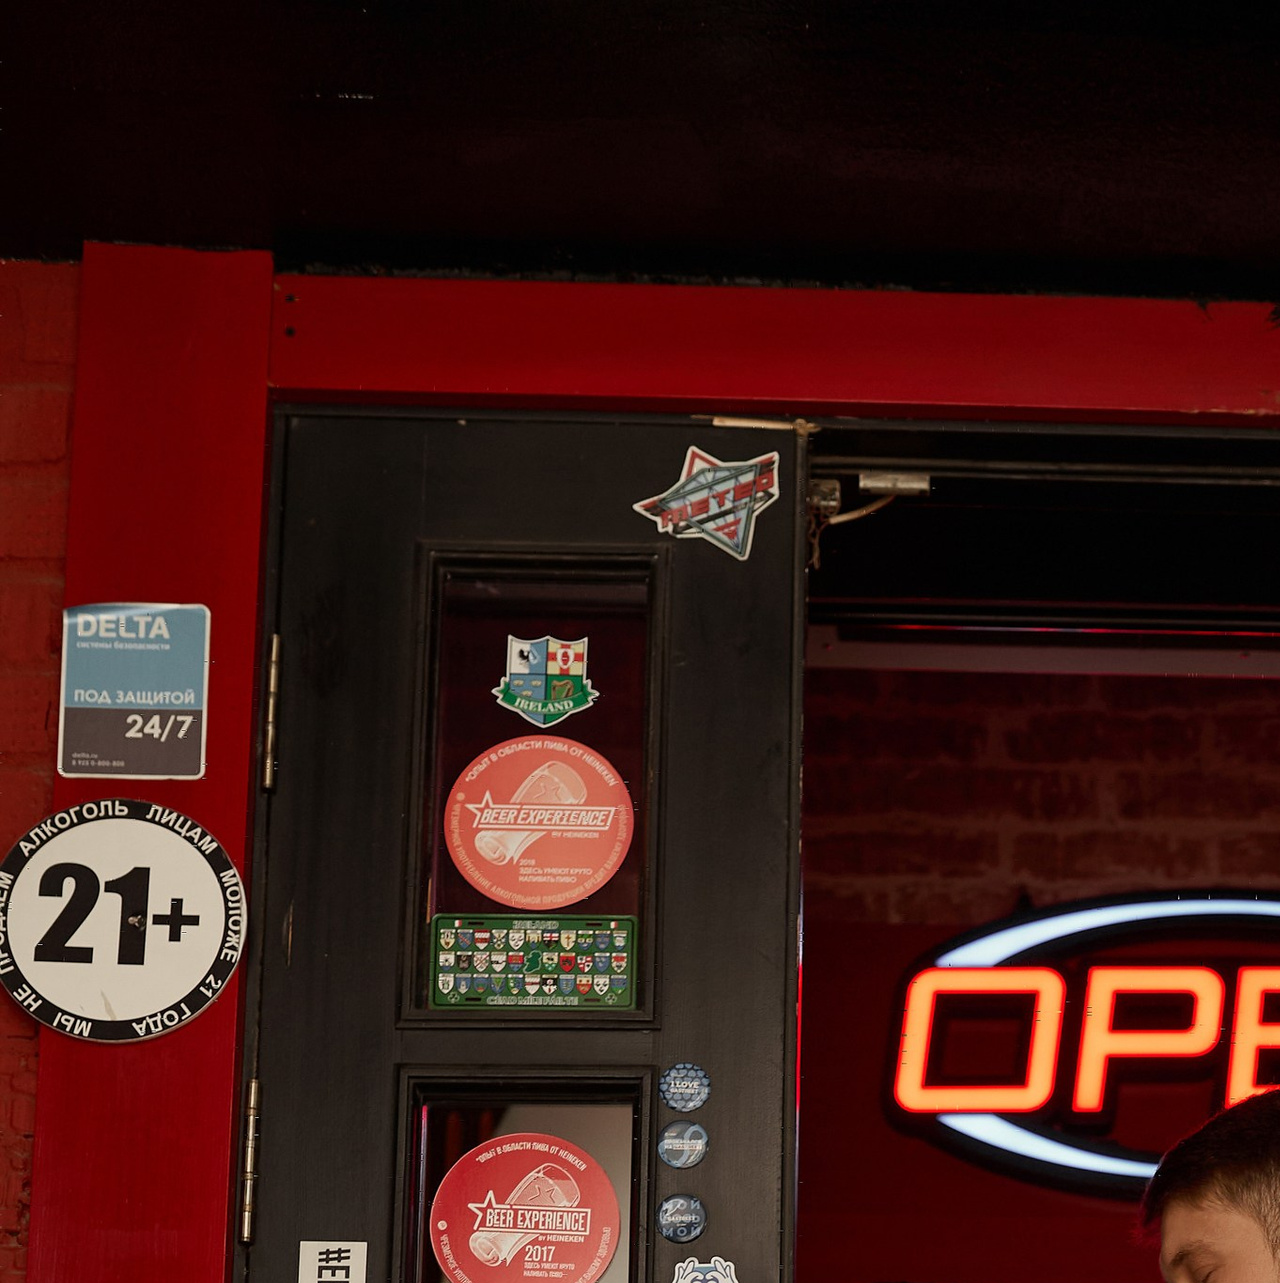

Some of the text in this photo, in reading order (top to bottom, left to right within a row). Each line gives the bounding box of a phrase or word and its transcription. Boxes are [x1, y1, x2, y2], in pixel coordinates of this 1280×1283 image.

[77, 613, 170, 639] DELTA
[74, 688, 195, 705] ПОД ЗАЩИТОЙ
[514, 697, 574, 712] IRELAND
[125, 714, 194, 742] 24/7
[498, 741, 543, 759] ОБЛАСТИ
[543, 740, 568, 752] ПИВА
[569, 746, 583, 757] ОТ
[18, 800, 129, 857] АЛКОГОЛЬ
[146, 804, 218, 855] ЛИЦАМ
[480, 808, 608, 826] BEER EXPERIENCE
[33, 862, 200, 965] 21+
[220, 868, 243, 963] МОЛОЖЕ
[13, 983, 42, 1012] НЕ
[199, 974, 222, 998] 21
[52, 1012, 92, 1037] МЫ
[132, 1002, 192, 1036] ГОДА
[485, 1208, 586, 1231] BEER EXPERIENCE
[547, 1234, 585, 1243] HEINEKEN
[524, 1245, 556, 1262] 2017
